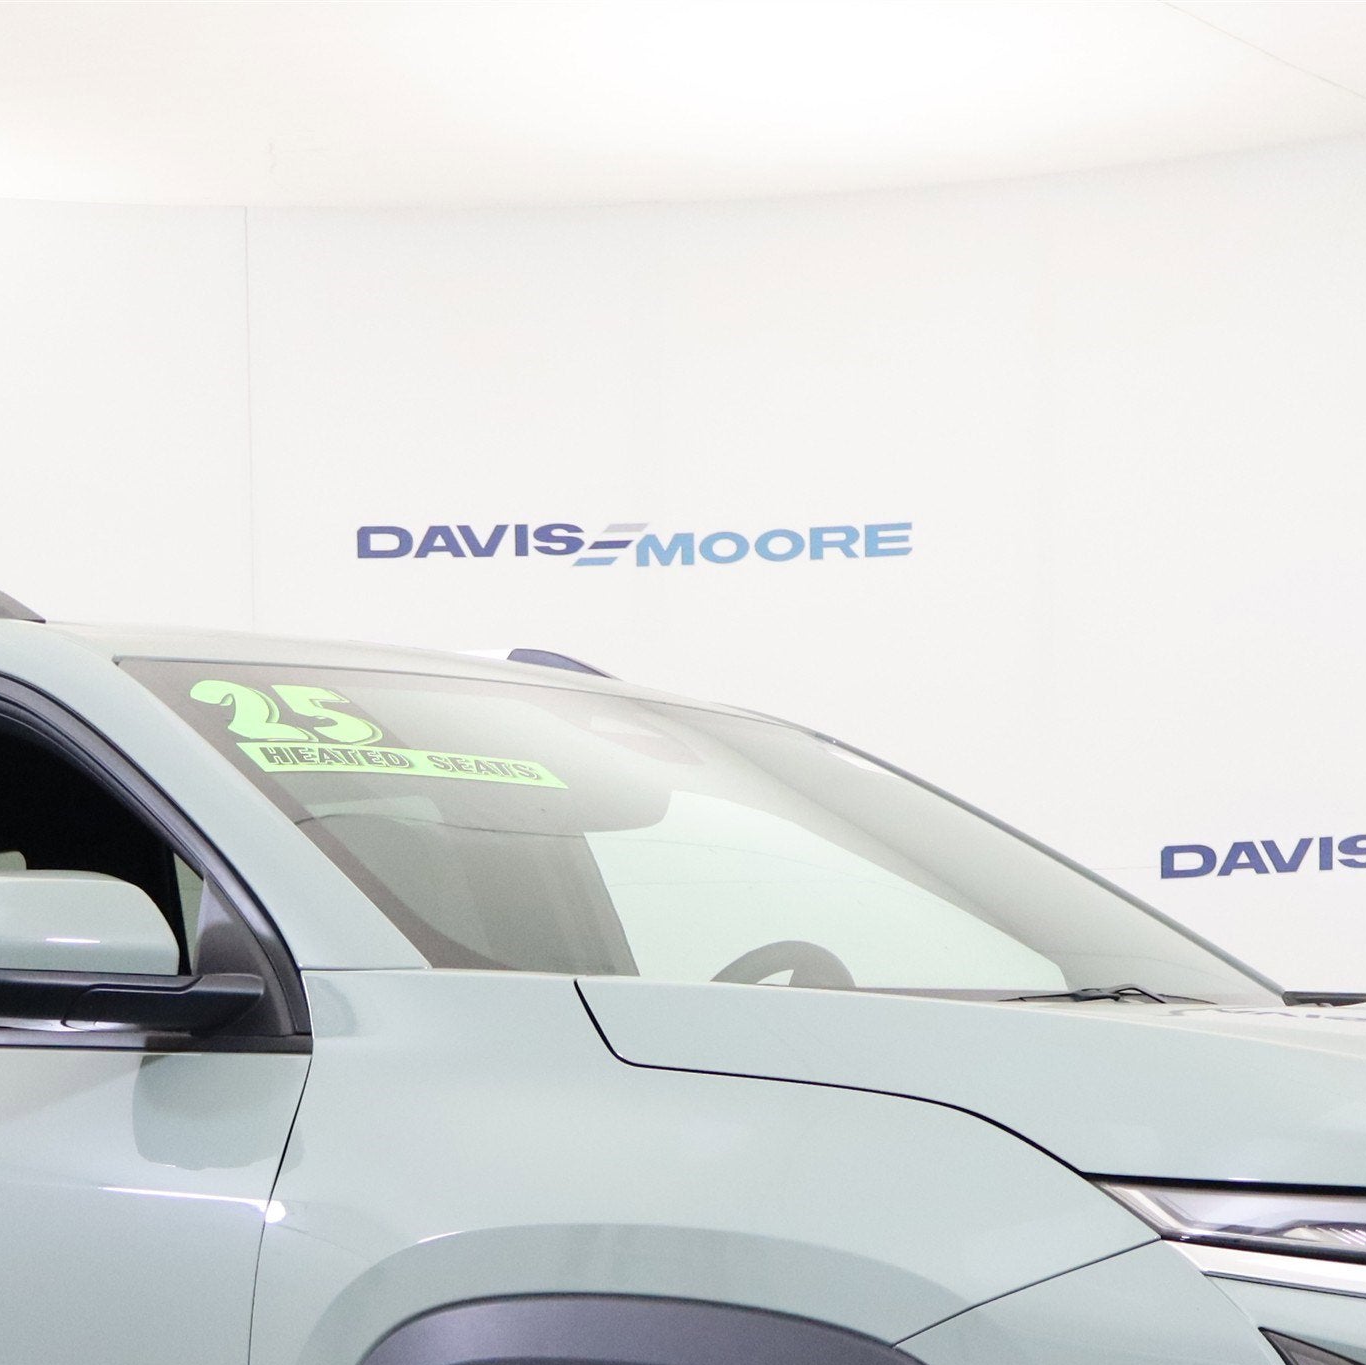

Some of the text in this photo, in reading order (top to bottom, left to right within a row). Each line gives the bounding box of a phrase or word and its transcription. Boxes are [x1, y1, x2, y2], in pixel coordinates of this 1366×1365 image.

[355, 521, 914, 568] DAVIS MOORE
[190, 679, 383, 745] 25
[258, 745, 543, 782] HEATED SEATS
